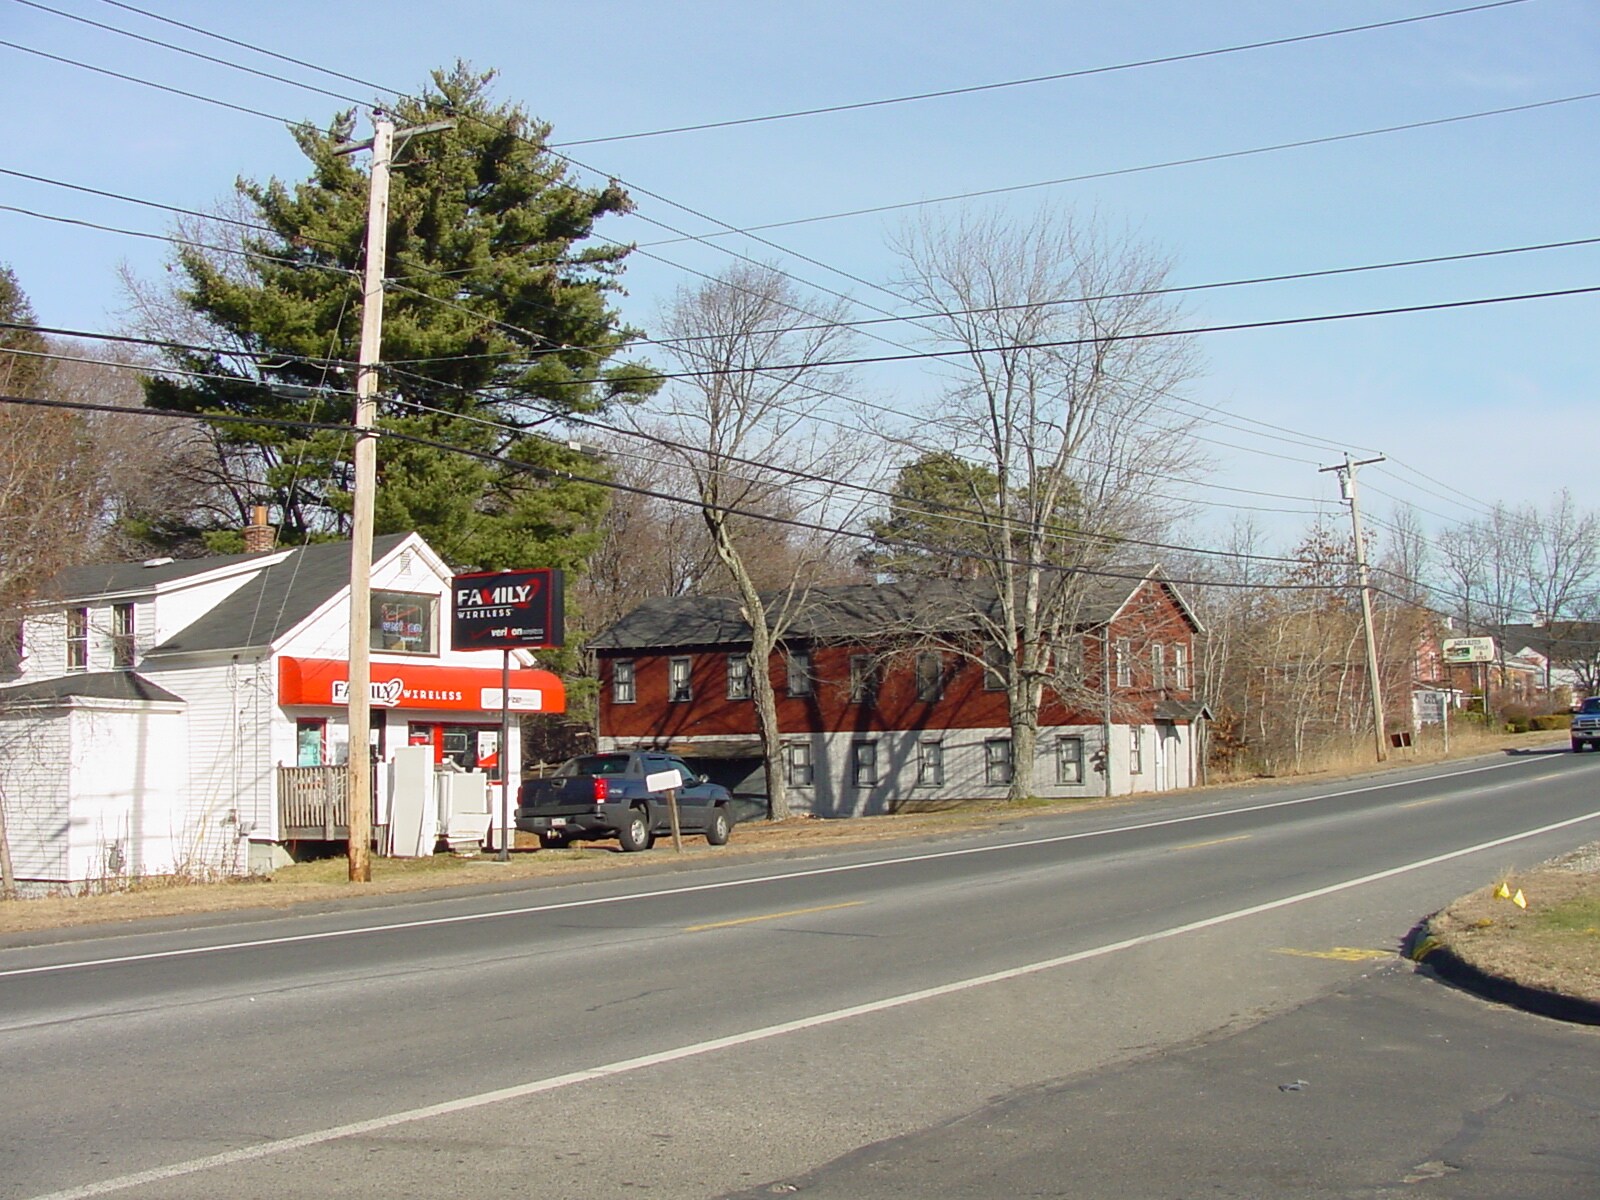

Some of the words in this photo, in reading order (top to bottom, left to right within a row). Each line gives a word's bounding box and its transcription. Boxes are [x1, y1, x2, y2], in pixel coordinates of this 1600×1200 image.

[457, 585, 531, 606] FAMILY
[457, 608, 512, 620] WIRELESS
[334, 683, 394, 703] FILY
[402, 689, 463, 701] WIRELESS
